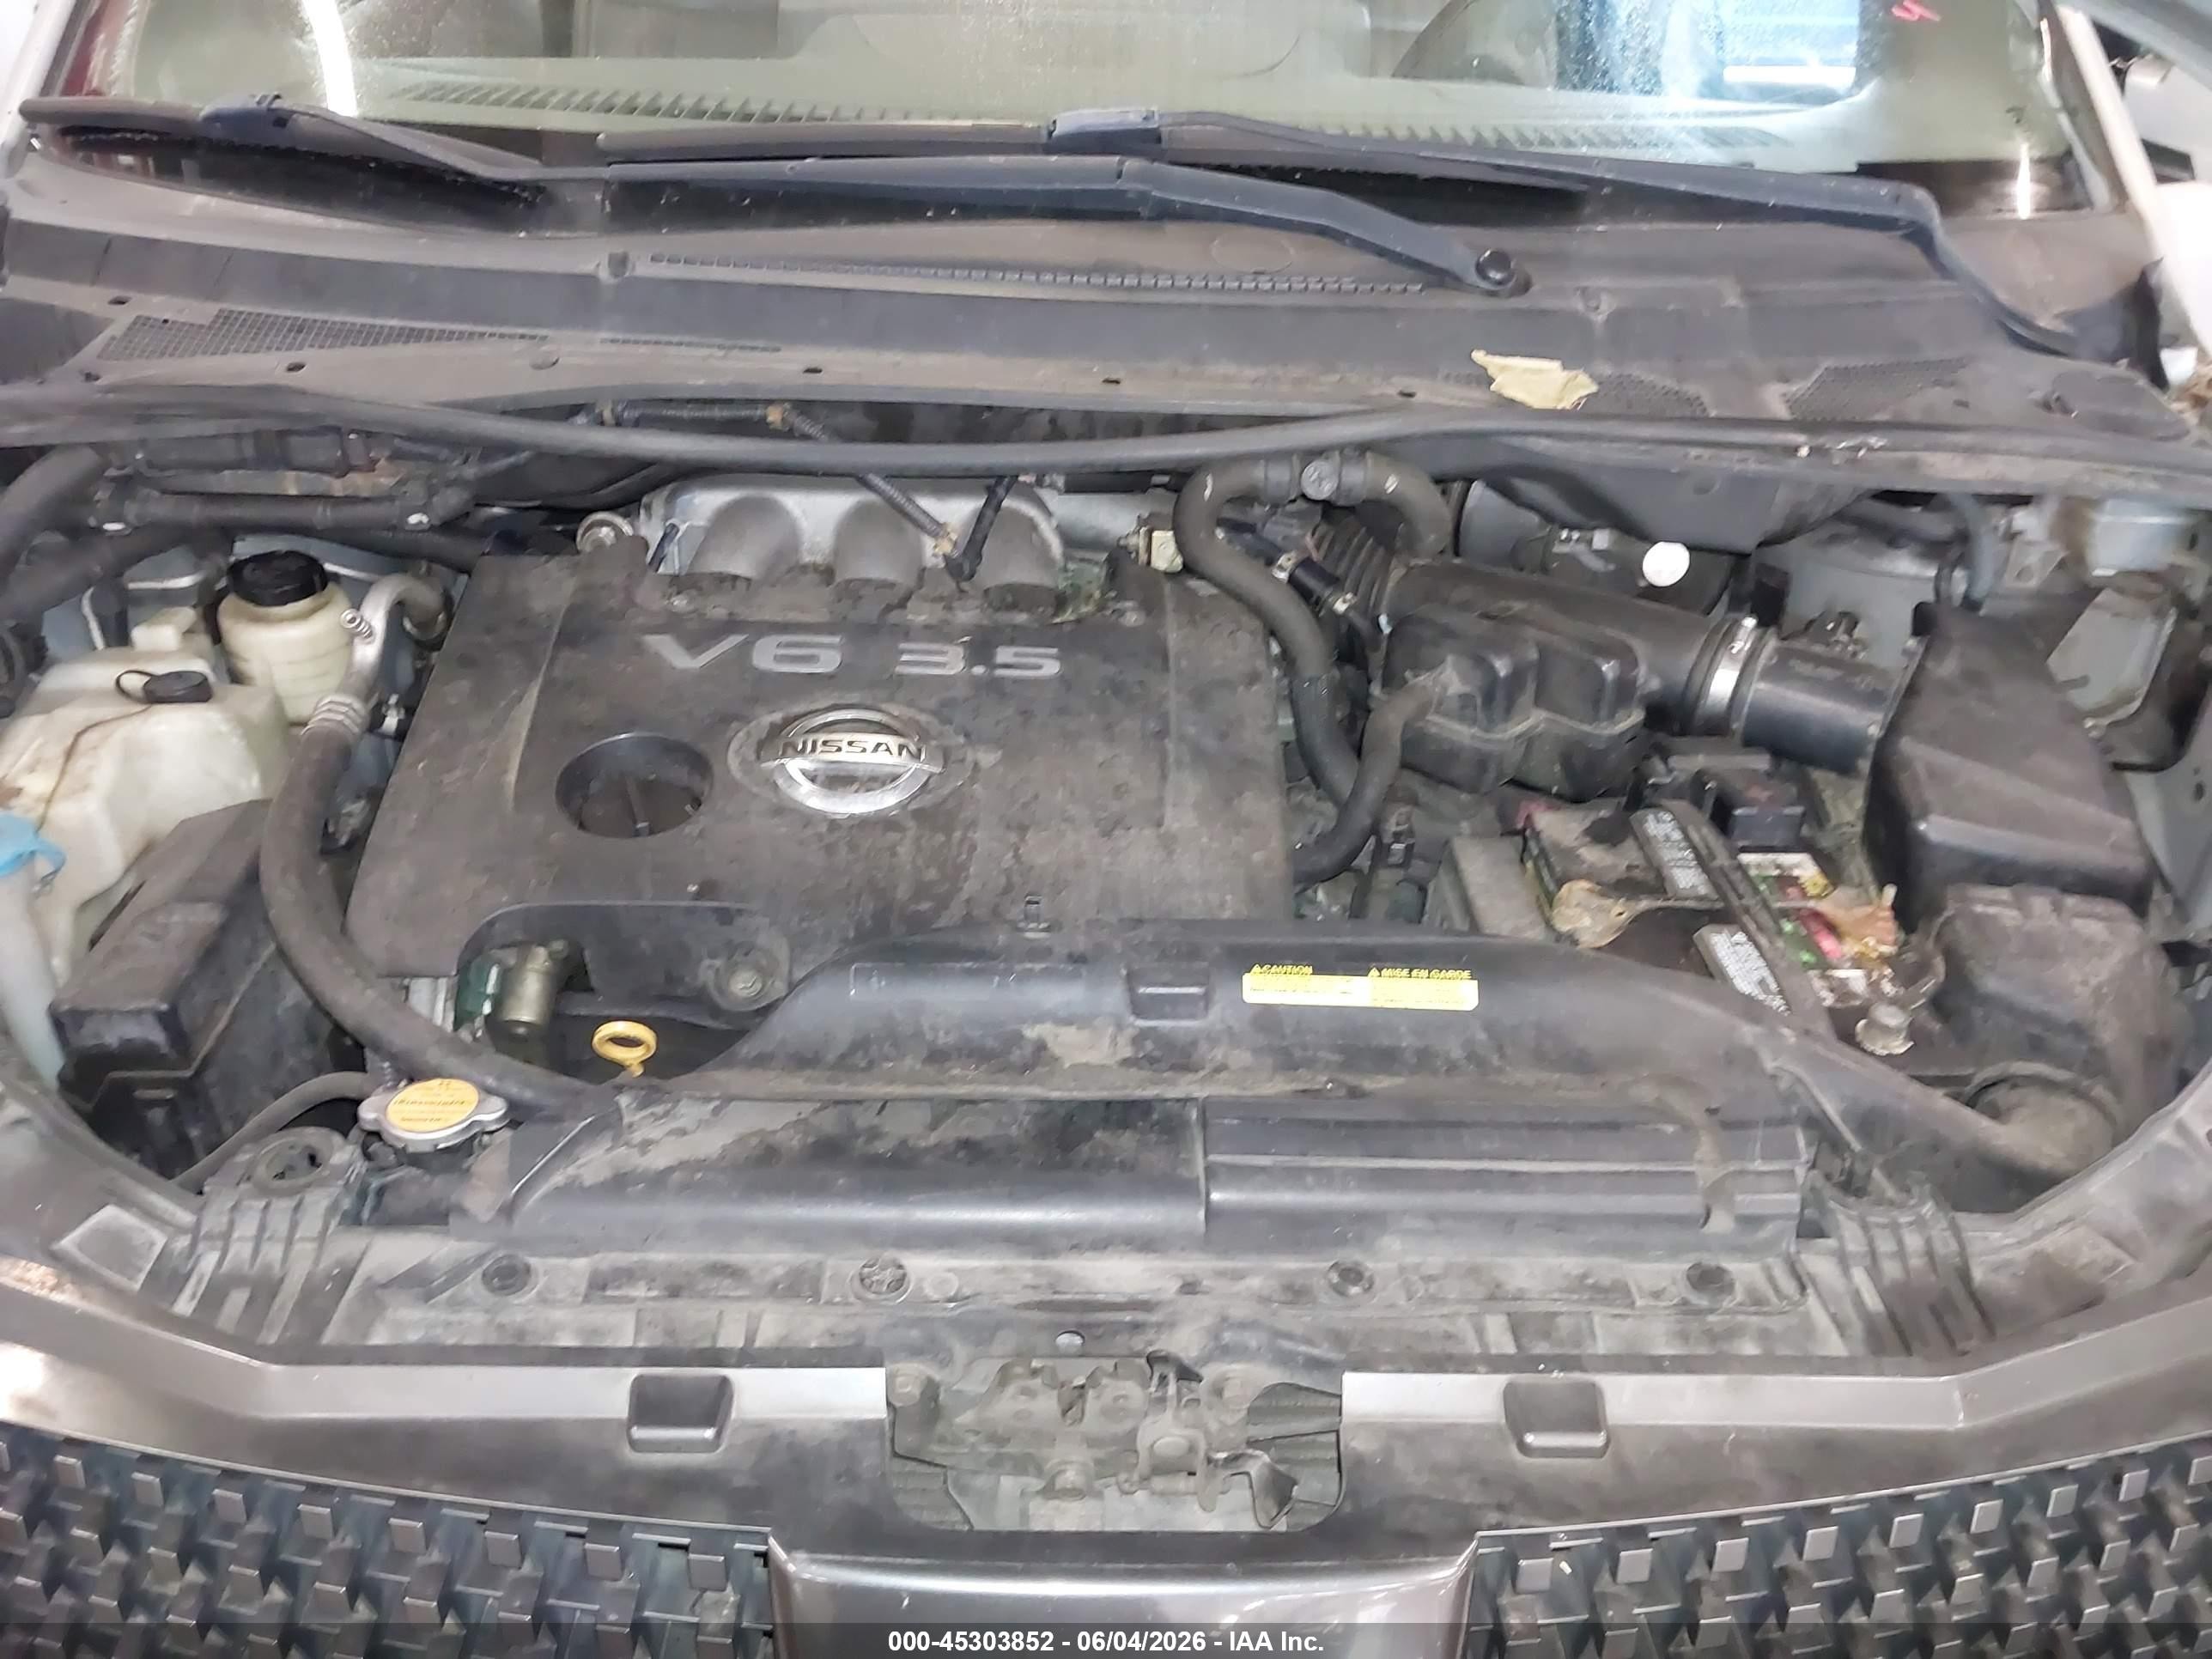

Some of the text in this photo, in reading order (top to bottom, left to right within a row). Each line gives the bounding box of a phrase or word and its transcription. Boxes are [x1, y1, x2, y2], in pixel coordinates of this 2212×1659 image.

[640, 633, 1062, 678] V6 3.5
[778, 738, 927, 763] NISSAN
[1262, 964, 1313, 975] CAUTION
